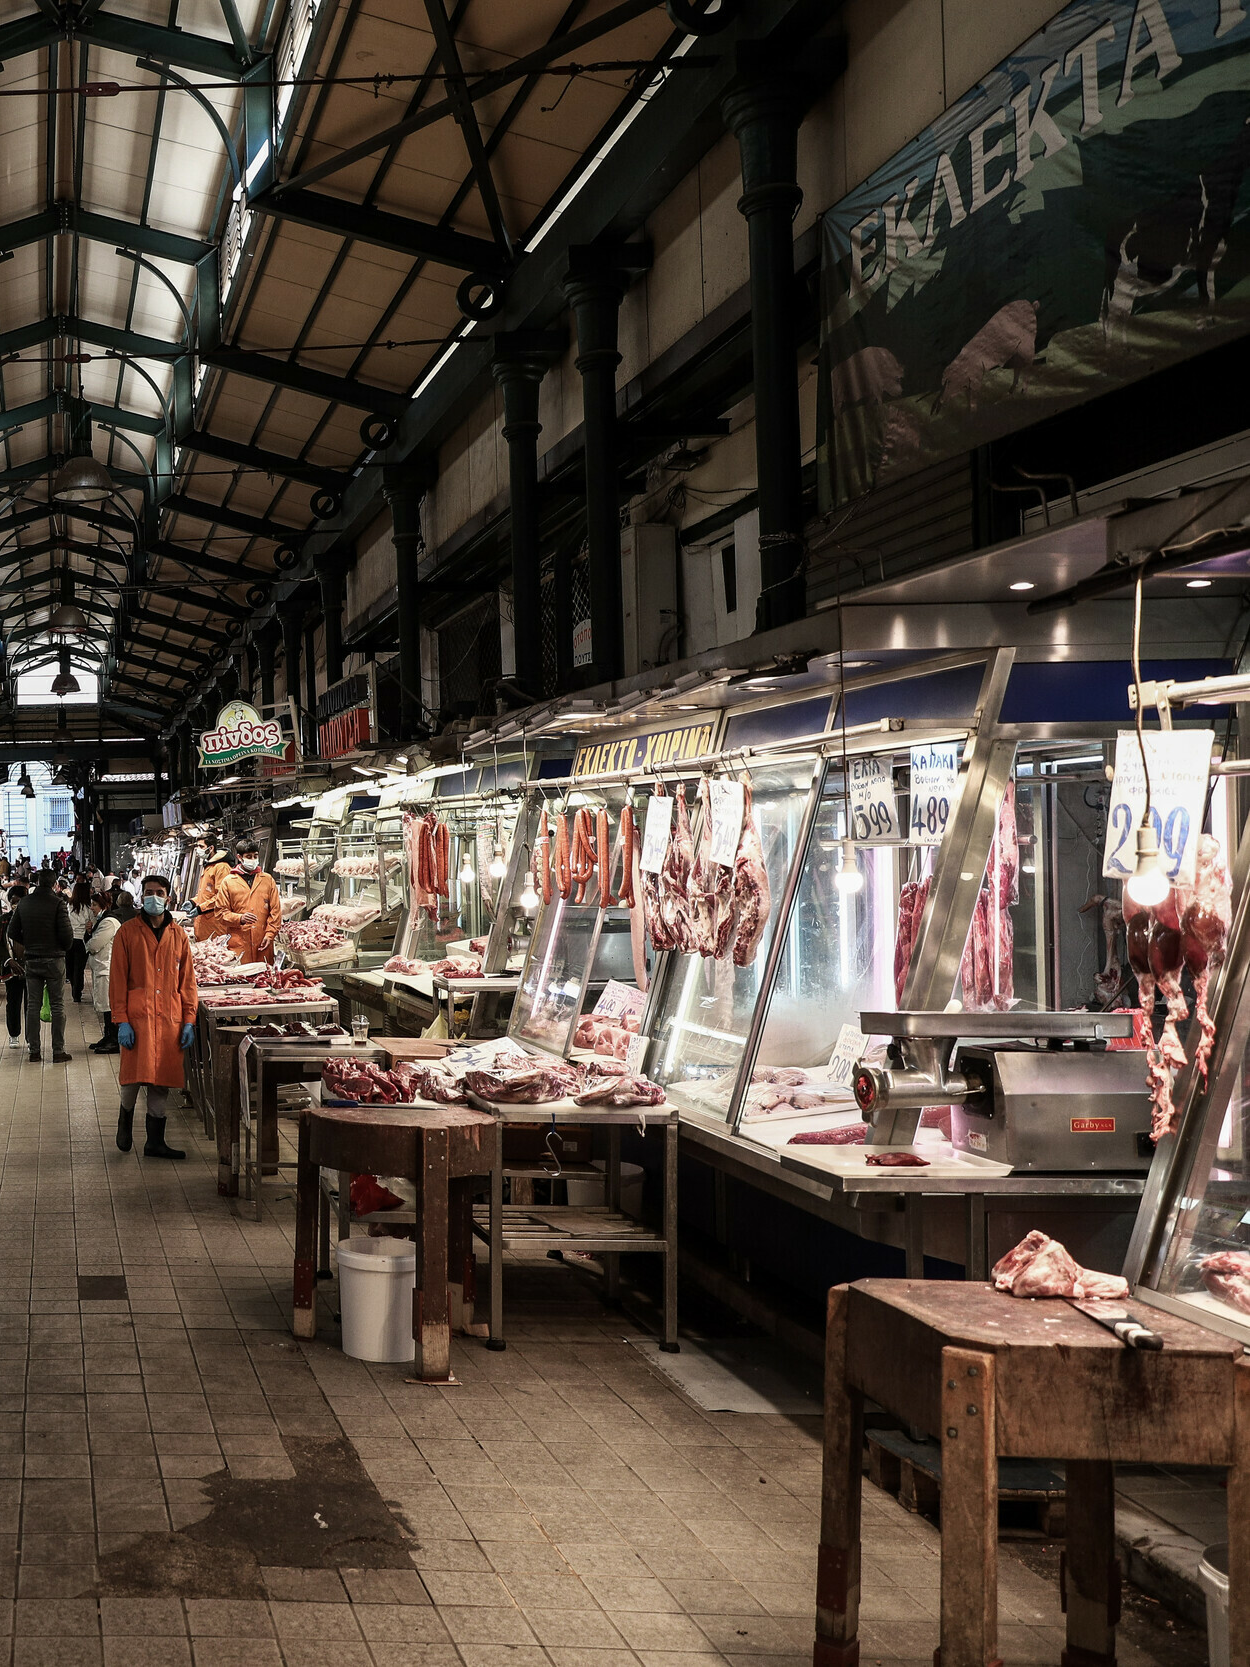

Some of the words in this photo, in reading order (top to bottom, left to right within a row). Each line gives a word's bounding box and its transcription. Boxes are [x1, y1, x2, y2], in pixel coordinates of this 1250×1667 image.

[849, 0, 1183, 298] ΕΚΛΕΚΤΑ
[854, 800, 892, 840] 599
[911, 793, 950, 837] 489
[1073, 1121, 1100, 1130] Garby
